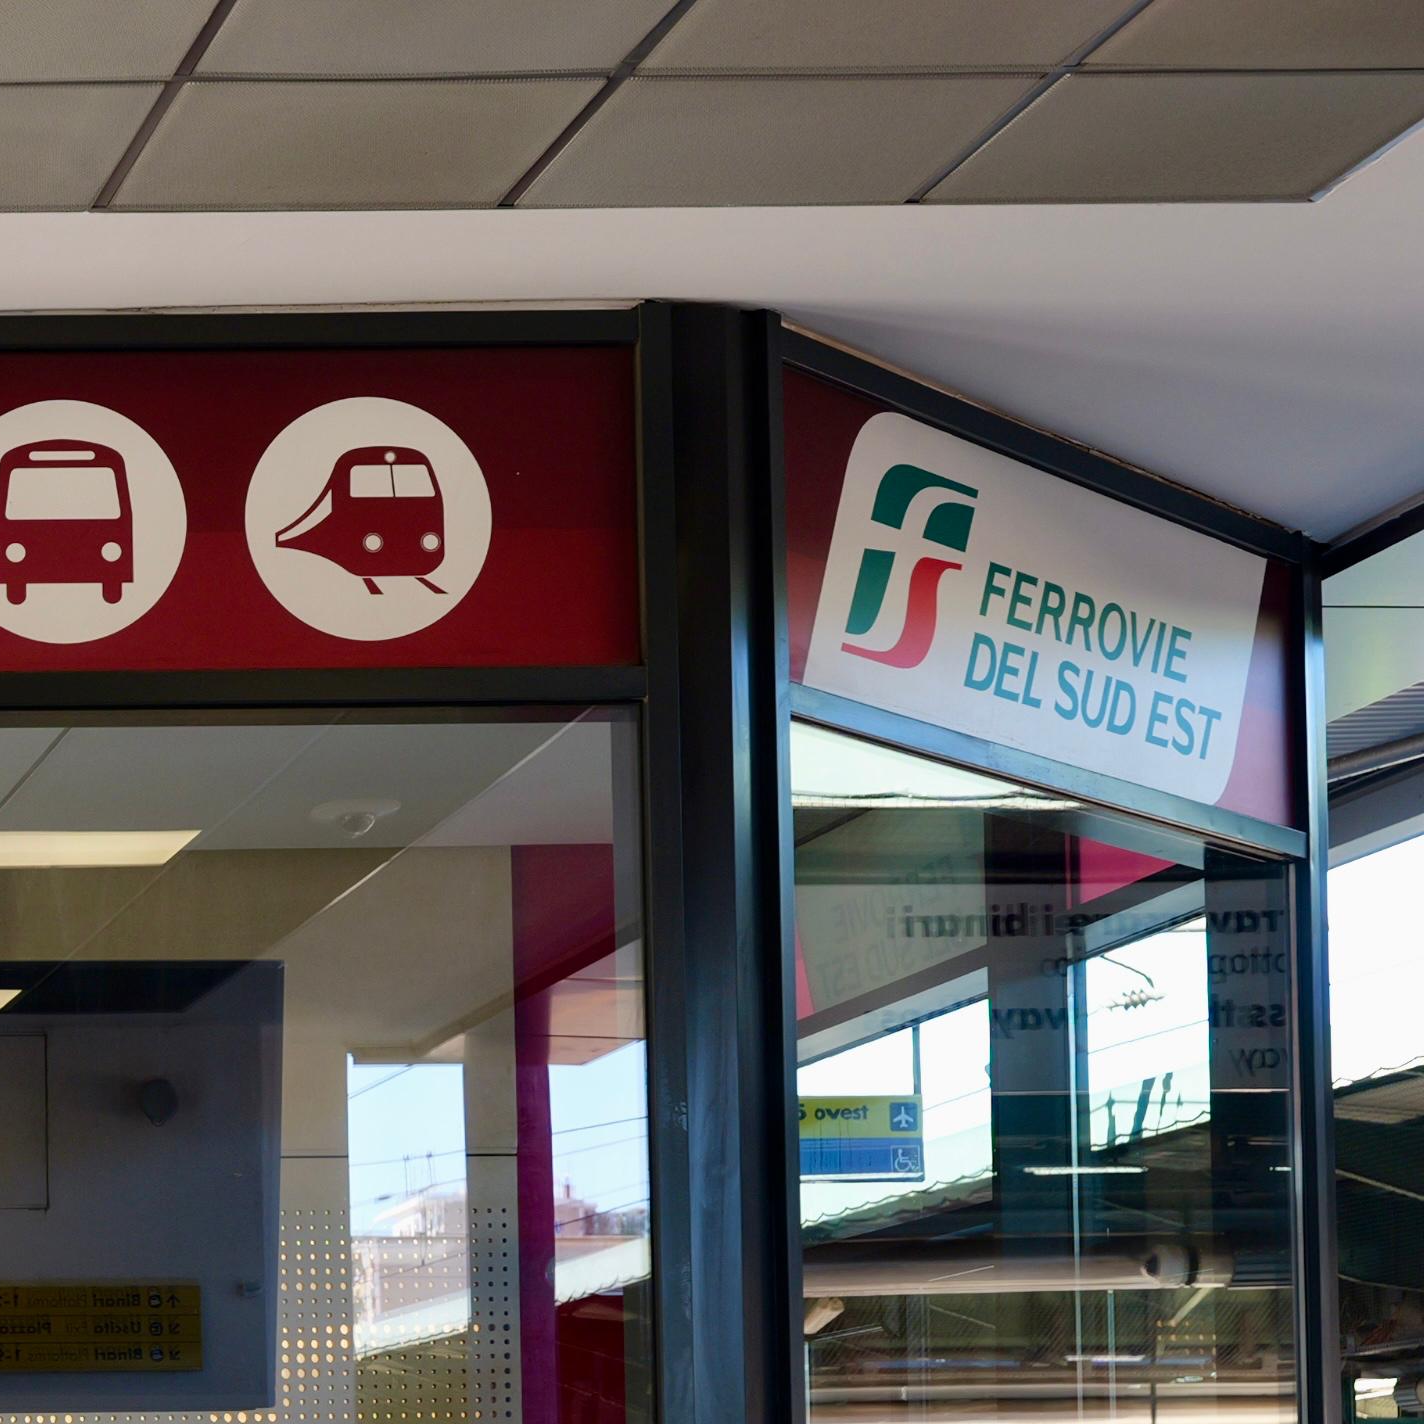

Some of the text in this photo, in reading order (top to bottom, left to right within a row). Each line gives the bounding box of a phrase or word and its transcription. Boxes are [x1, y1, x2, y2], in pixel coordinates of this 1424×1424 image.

[979, 561, 1192, 684] FERROVIE
[963, 632, 1222, 760] DEL SUD EST
[814, 1104, 870, 1120] ovest
